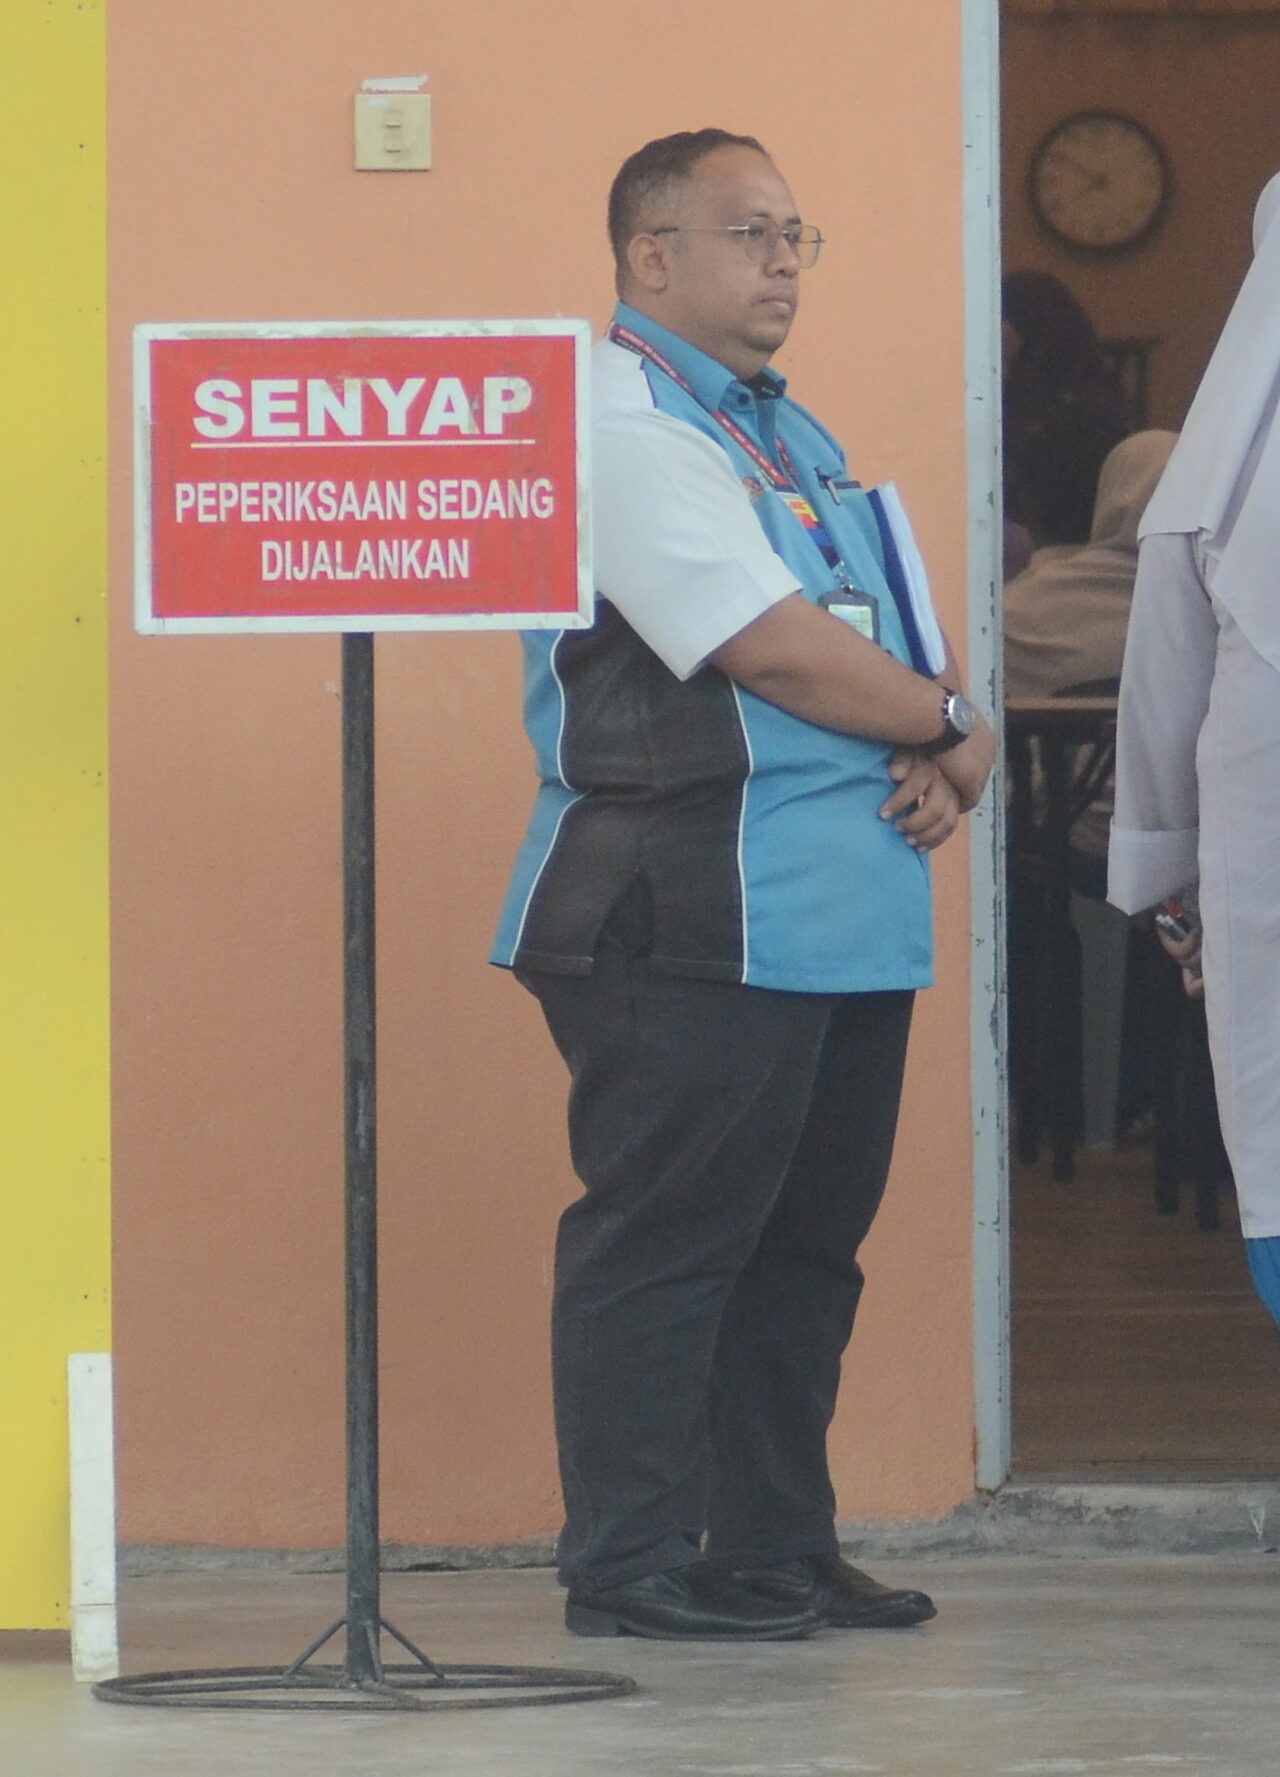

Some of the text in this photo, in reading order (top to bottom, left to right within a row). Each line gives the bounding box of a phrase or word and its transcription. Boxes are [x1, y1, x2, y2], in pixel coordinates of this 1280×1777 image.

[193, 377, 533, 439] SENYAP
[175, 478, 554, 523] PEPERIKSAAN SEDANG
[261, 539, 470, 581] DIJALANKAN
